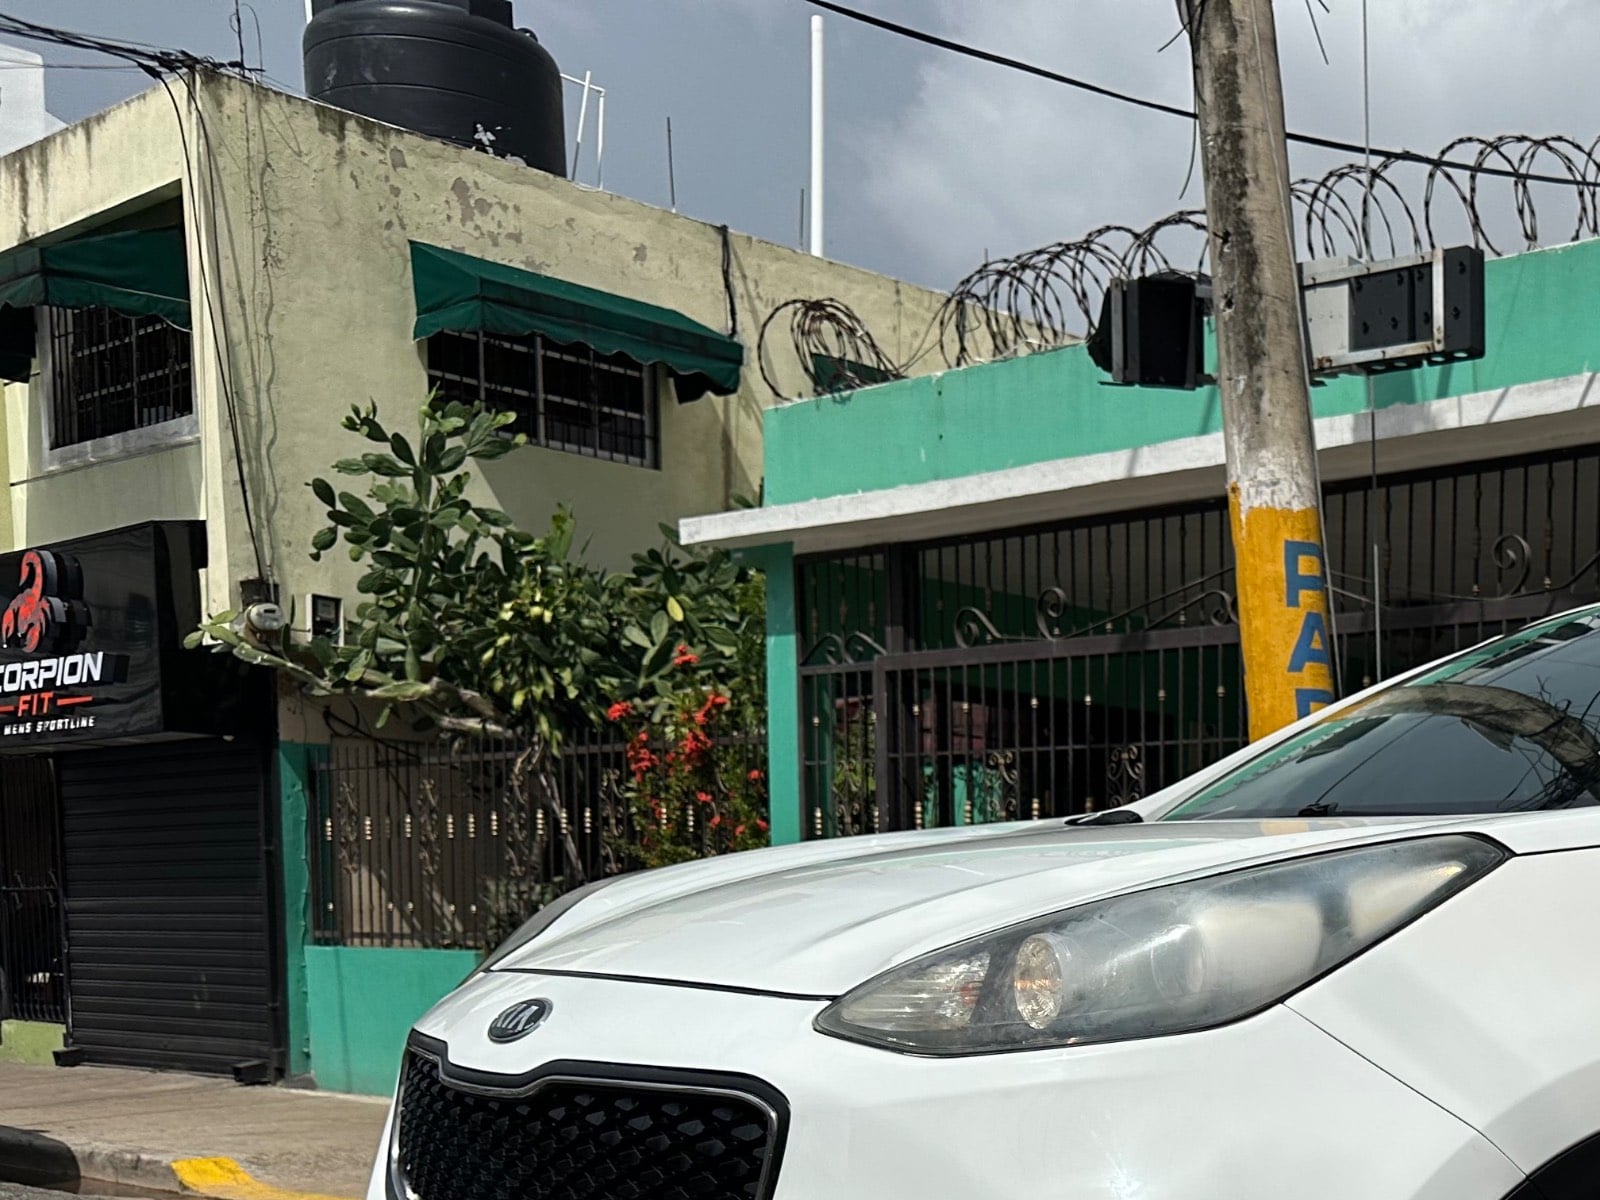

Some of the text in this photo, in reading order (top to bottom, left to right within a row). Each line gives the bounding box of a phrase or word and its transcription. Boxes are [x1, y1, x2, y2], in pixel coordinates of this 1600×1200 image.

[0, 651, 103, 693] ORPION
[18, 691, 54, 717] FIT
[4, 716, 95, 735] MENS SPORTLINE
